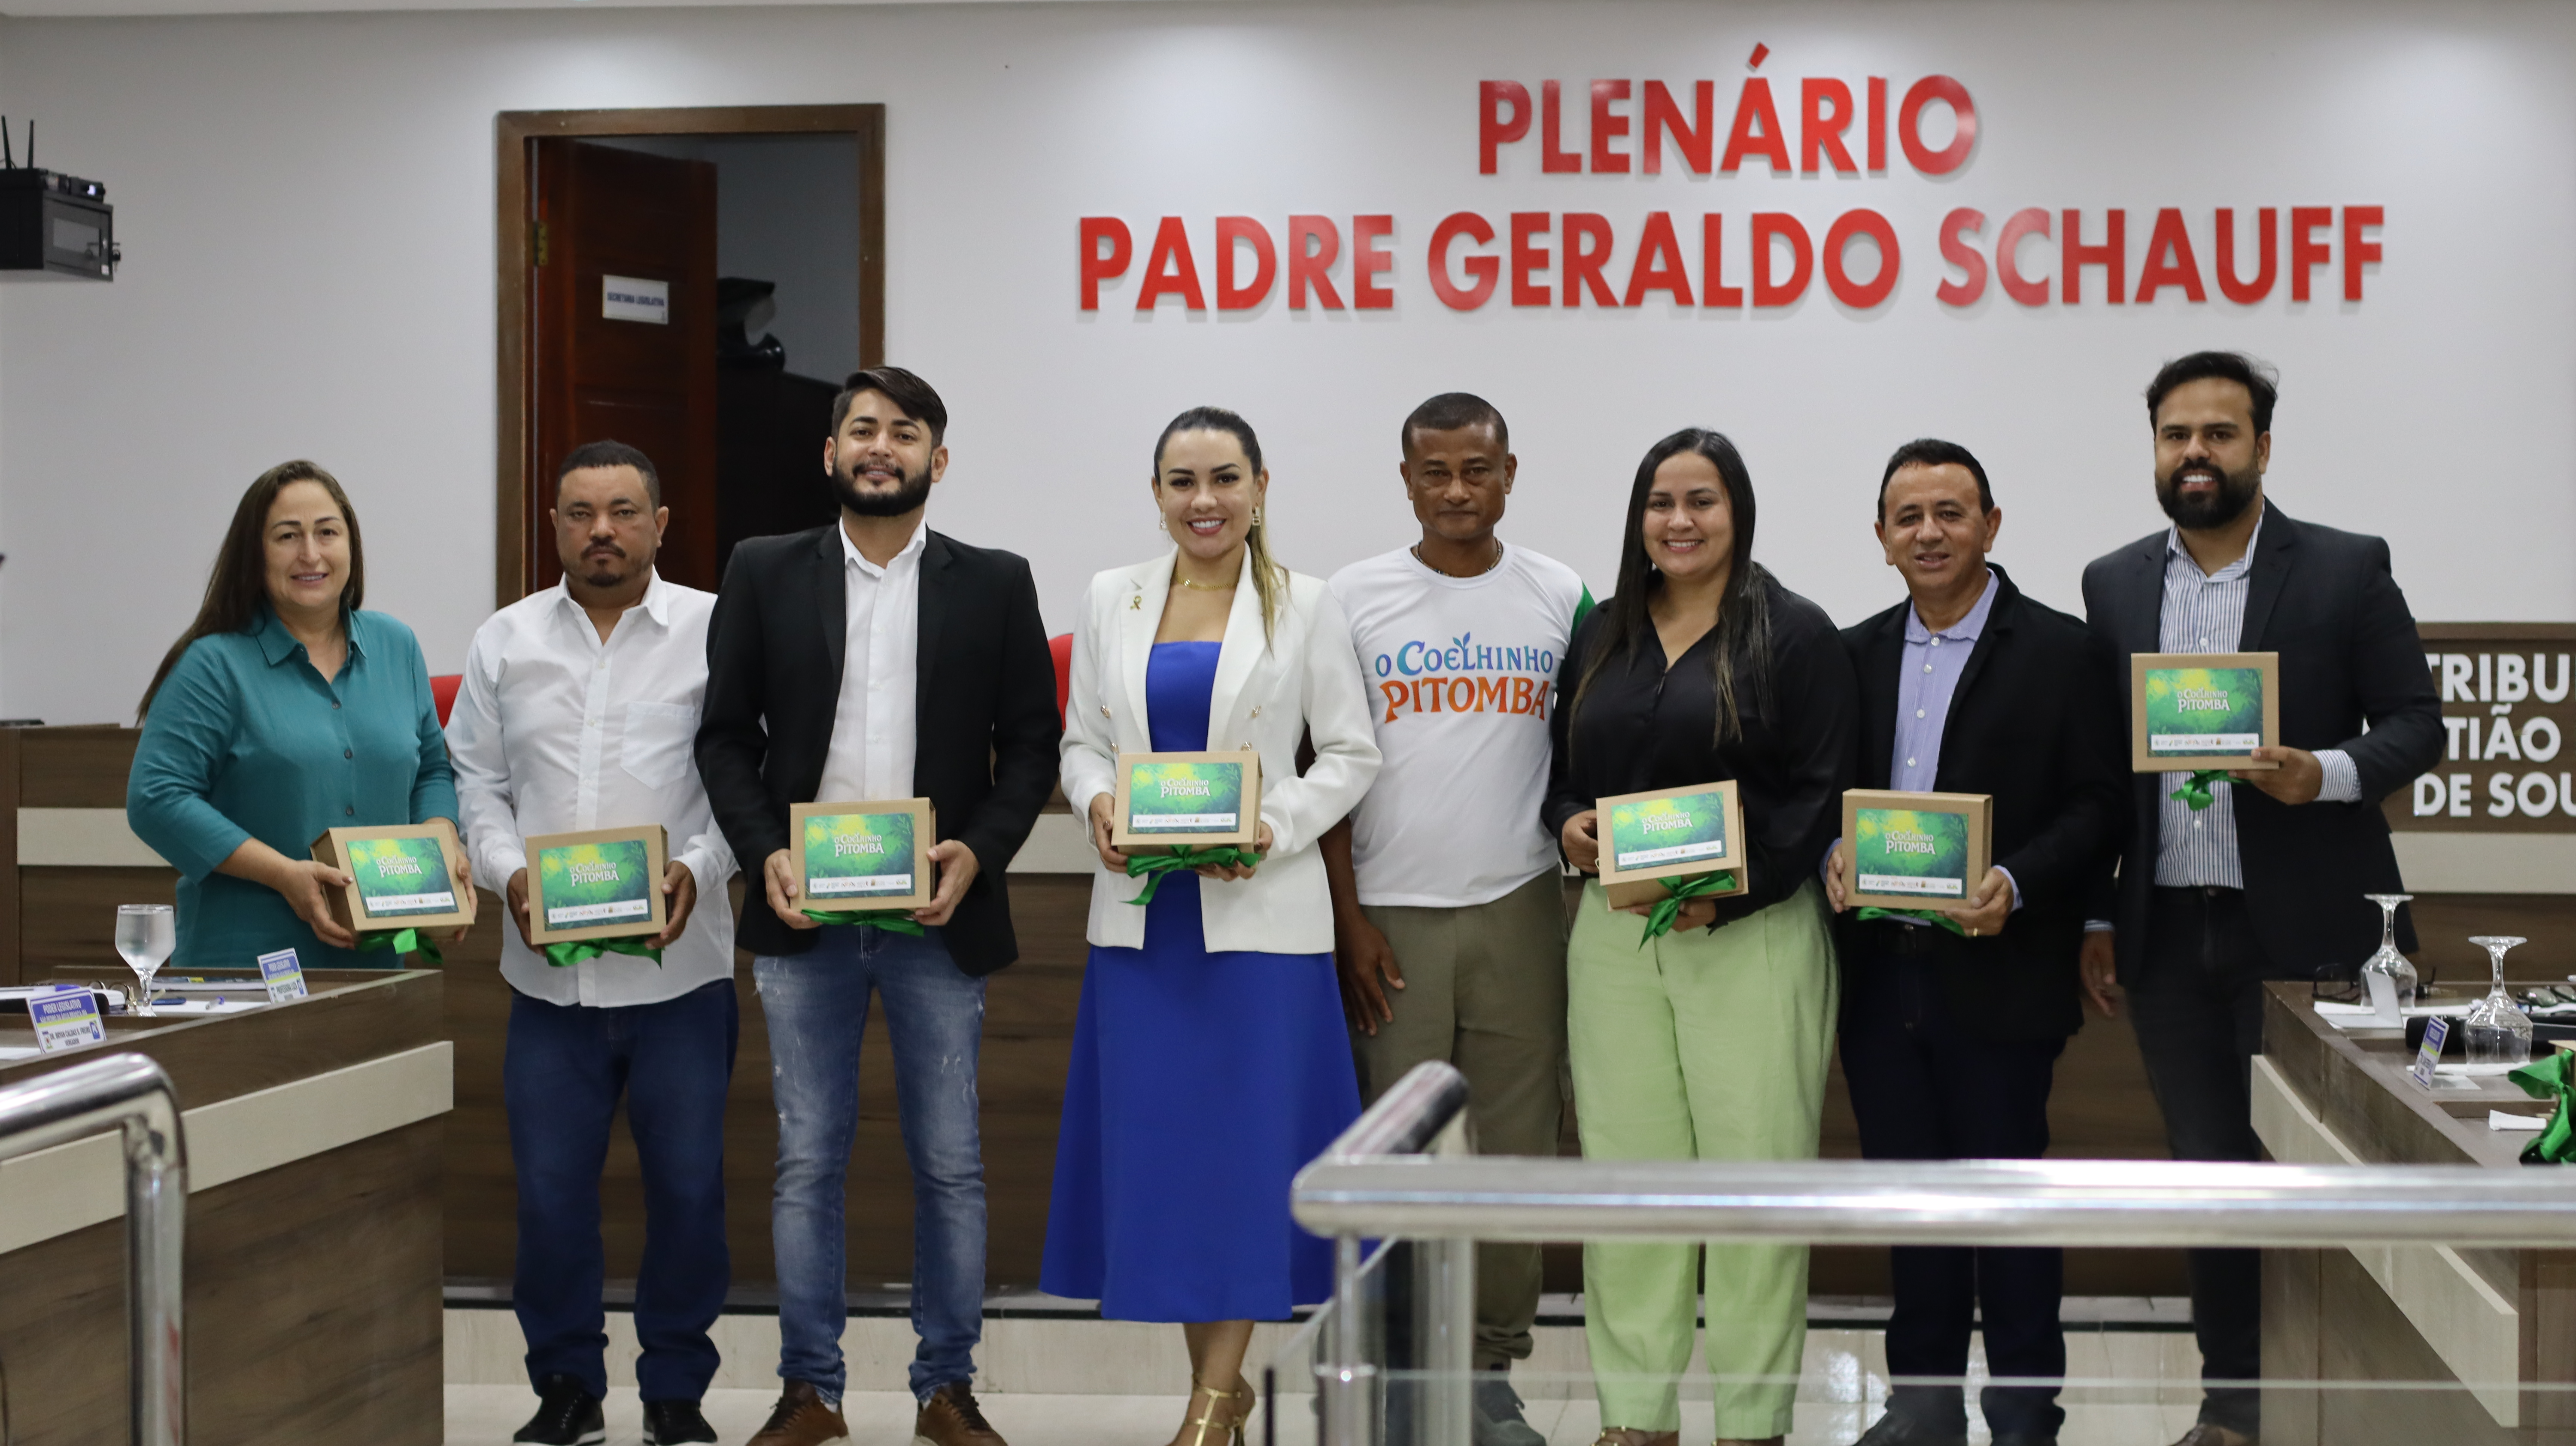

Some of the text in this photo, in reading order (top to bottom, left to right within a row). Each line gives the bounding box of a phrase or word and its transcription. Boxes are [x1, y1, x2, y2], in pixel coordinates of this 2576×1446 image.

[1480, 43, 1974, 174] PLENÁRIO
[1080, 207, 2383, 311] PADRE GERALDO SCHAUFF
[1375, 654, 1391, 677] O
[2425, 653, 2576, 703] RIBU
[1379, 676, 1550, 724] PITOMBA
[2178, 699, 2230, 713] PITOMBA
[2442, 703, 2561, 762] TIÃO
[1160, 786, 1210, 798] PITOMBA
[2413, 772, 2472, 816] DE
[1643, 818, 1693, 835] PITOMBA
[835, 843, 884, 857] PITOMBA
[1886, 840, 1936, 855] PITOMBA
[379, 863, 422, 878] PITOMBA
[571, 870, 620, 887] PITOMBA
[42, 998, 82, 1015] PODER LEGISLATIVO
